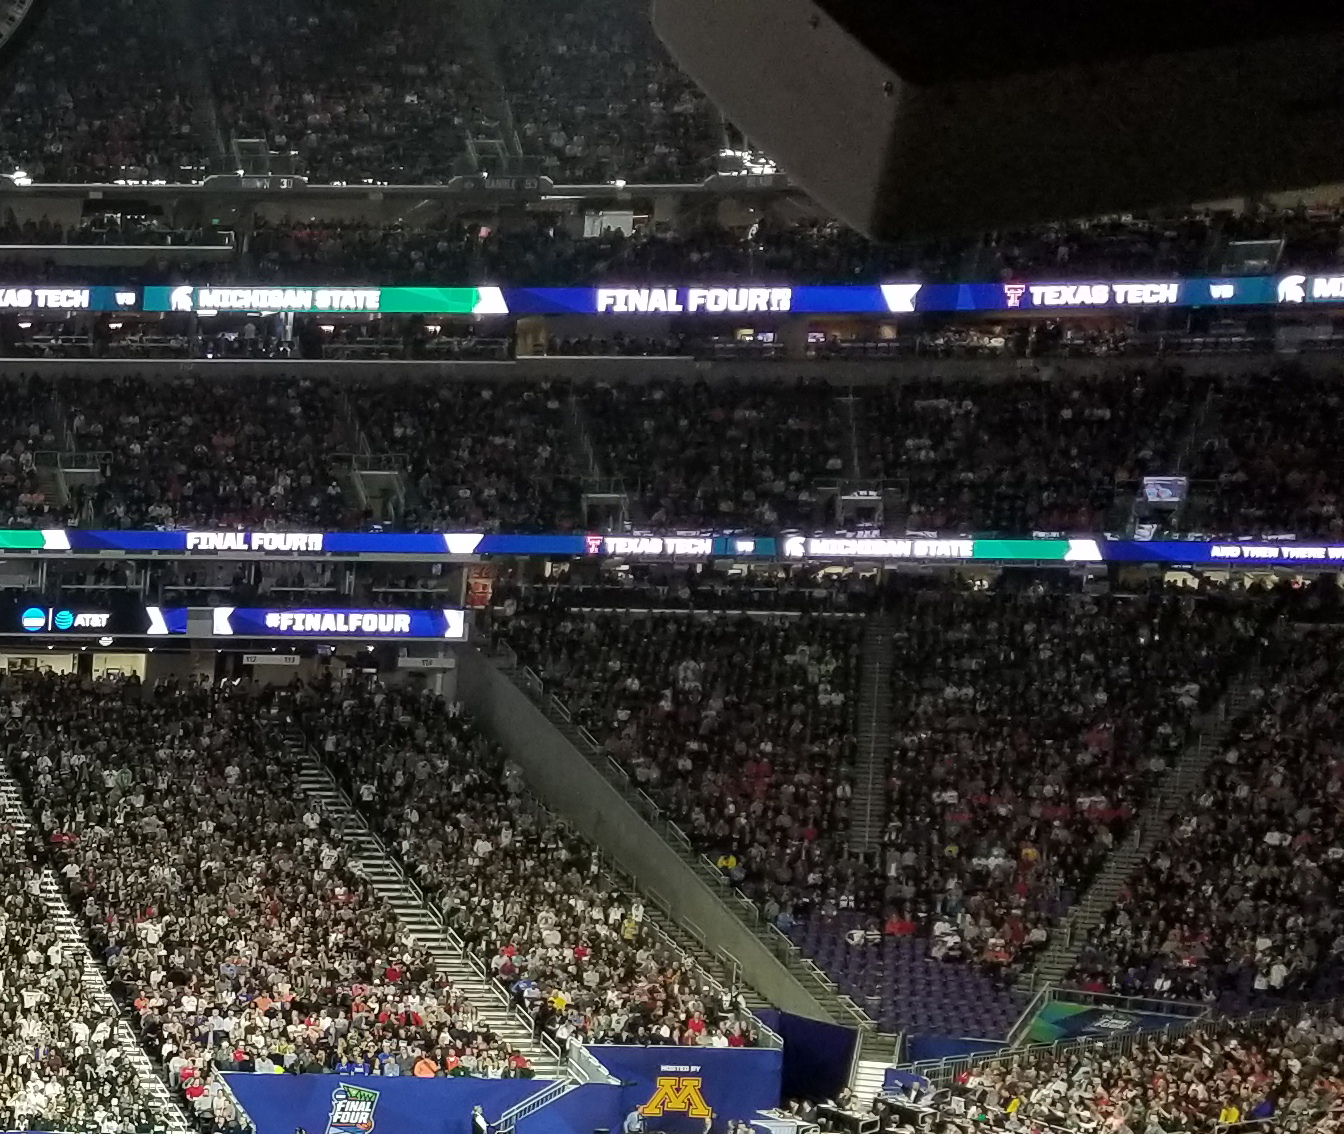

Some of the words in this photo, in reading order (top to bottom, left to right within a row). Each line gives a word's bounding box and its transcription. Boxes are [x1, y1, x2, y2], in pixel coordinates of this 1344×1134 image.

[35, 289, 89, 307] TECH
[197, 287, 312, 312] MICHIGAN
[597, 289, 682, 312] FINAL
[688, 288, 769, 311] FOUR
[1030, 285, 1109, 305] TEXAS
[1113, 284, 1178, 303] TECH
[187, 532, 248, 550] FINAL
[252, 533, 309, 550] FOUR
[74, 614, 109, 627] AT&T
[266, 613, 410, 632] #FINALFOUR
[660, 1064, 689, 1072] HOSTED
[690, 1064, 701, 1072] BY
[336, 1100, 372, 1112] FINAL
[332, 1111, 370, 1124] FOUR
